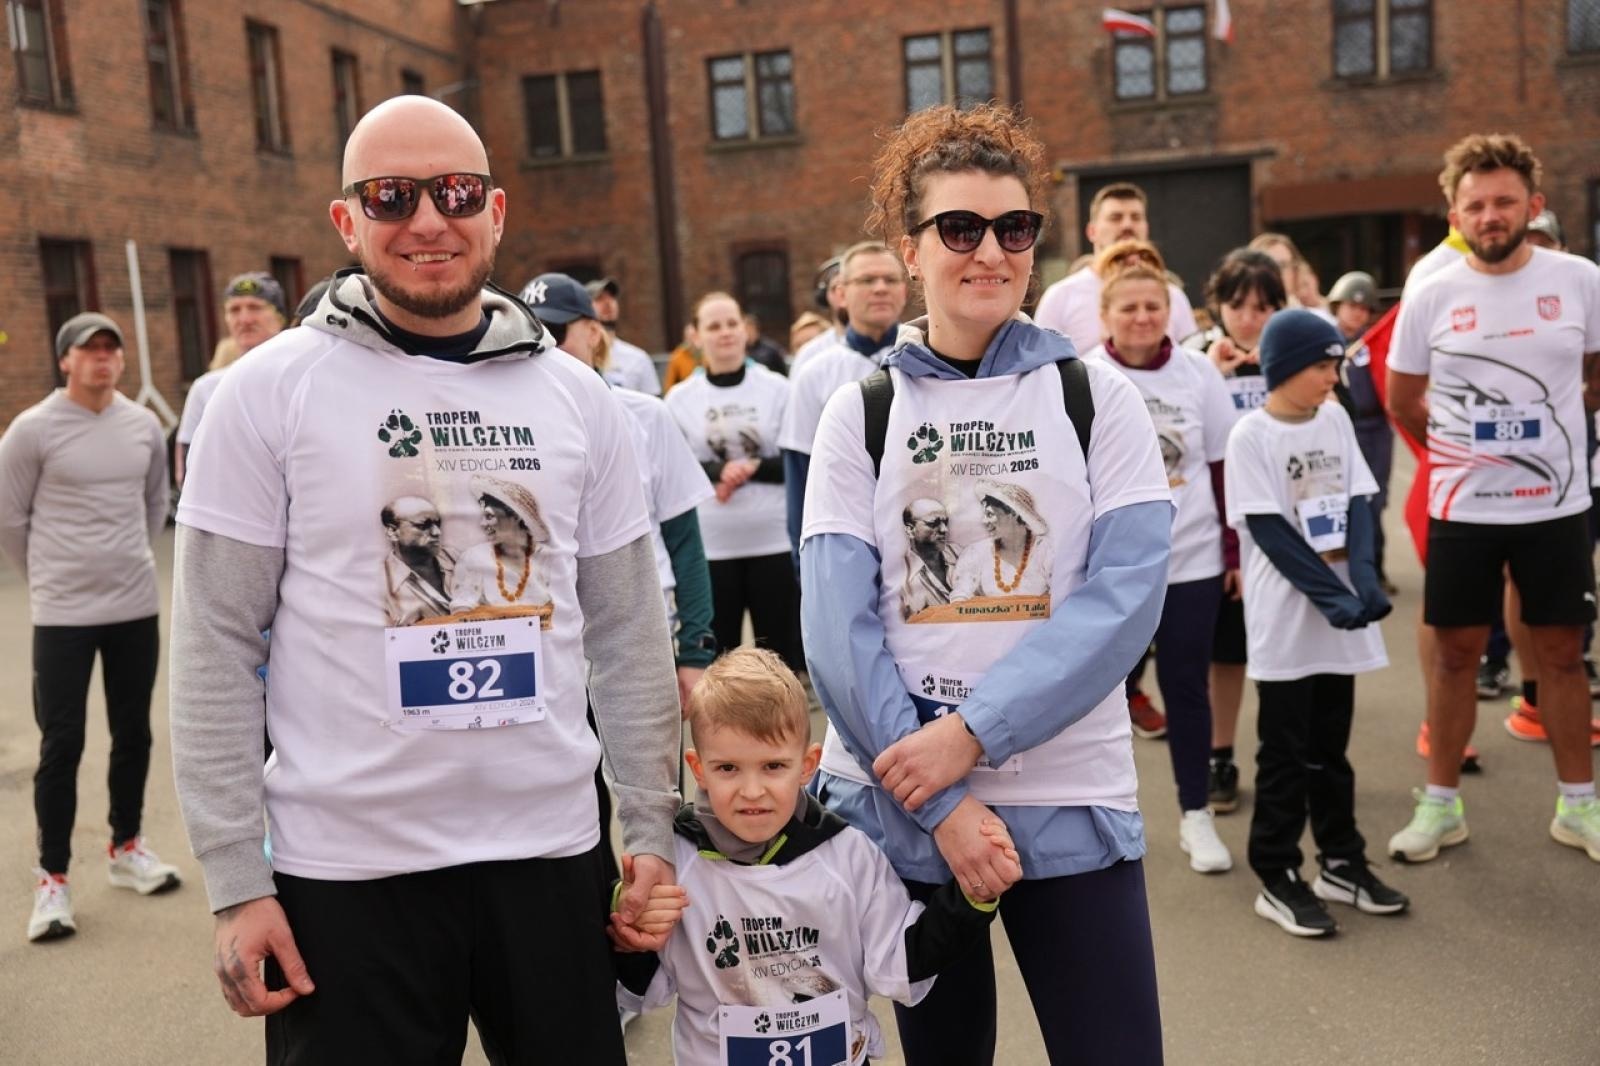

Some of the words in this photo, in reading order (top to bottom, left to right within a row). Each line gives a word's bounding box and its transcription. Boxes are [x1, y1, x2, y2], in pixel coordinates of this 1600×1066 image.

[524, 280, 548, 304] NY
[425, 410, 481, 425] TROPEM
[949, 420, 995, 433] TROPEM
[430, 426, 535, 446] WILCZYM
[1494, 420, 1524, 441] 80
[950, 430, 1036, 452] WILCZYM
[436, 458, 457, 471] XIV
[460, 458, 507, 471] EDYCJA
[509, 457, 541, 470] 2026
[949, 463, 968, 476] XIV
[970, 463, 1009, 476] EDYCJA
[1010, 458, 1039, 472] 2026
[455, 628, 482, 637] TROPEM
[456, 635, 506, 650] WILCZYM
[448, 658, 504, 700] 82
[939, 677, 963, 686] TROPEM
[740, 916, 783, 932] TROPEM
[751, 966, 769, 980] XIV
[770, 958, 810, 977] EDYCJA
[775, 1011, 800, 1020] TROPEM
[776, 1013, 820, 1031] WILCZYM
[768, 1035, 813, 1066] 81
